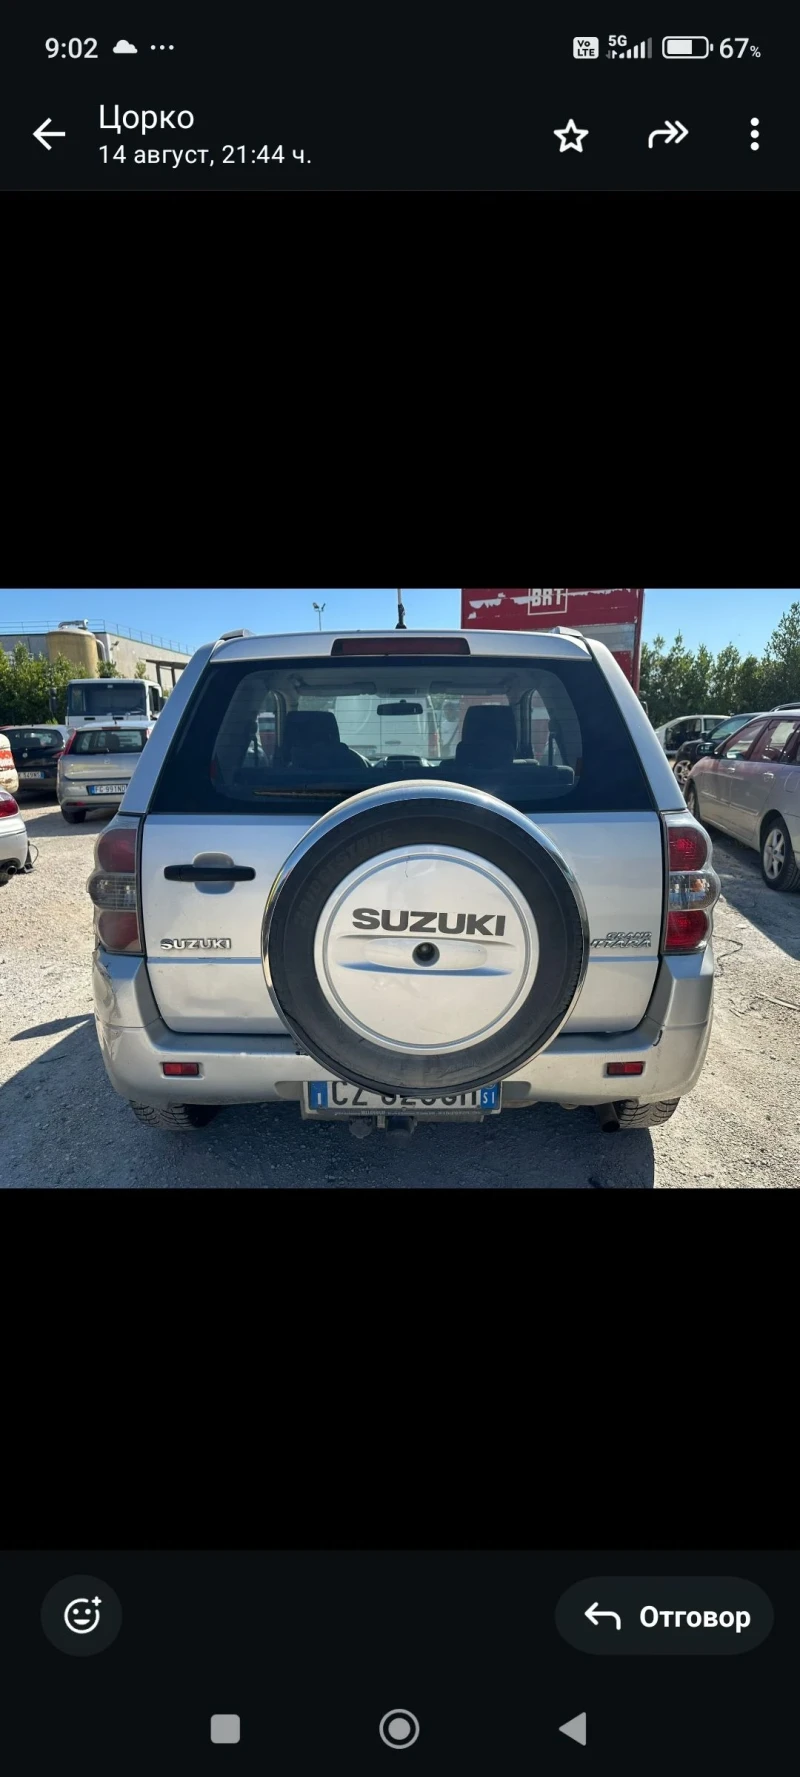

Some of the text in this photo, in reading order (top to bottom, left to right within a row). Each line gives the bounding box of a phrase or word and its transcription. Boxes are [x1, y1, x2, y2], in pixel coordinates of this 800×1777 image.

[531, 588, 564, 606] BRT
[352, 908, 506, 937] SUZUKI
[160, 938, 232, 950] SUZUKI
[482, 1091, 495, 1104] SI
